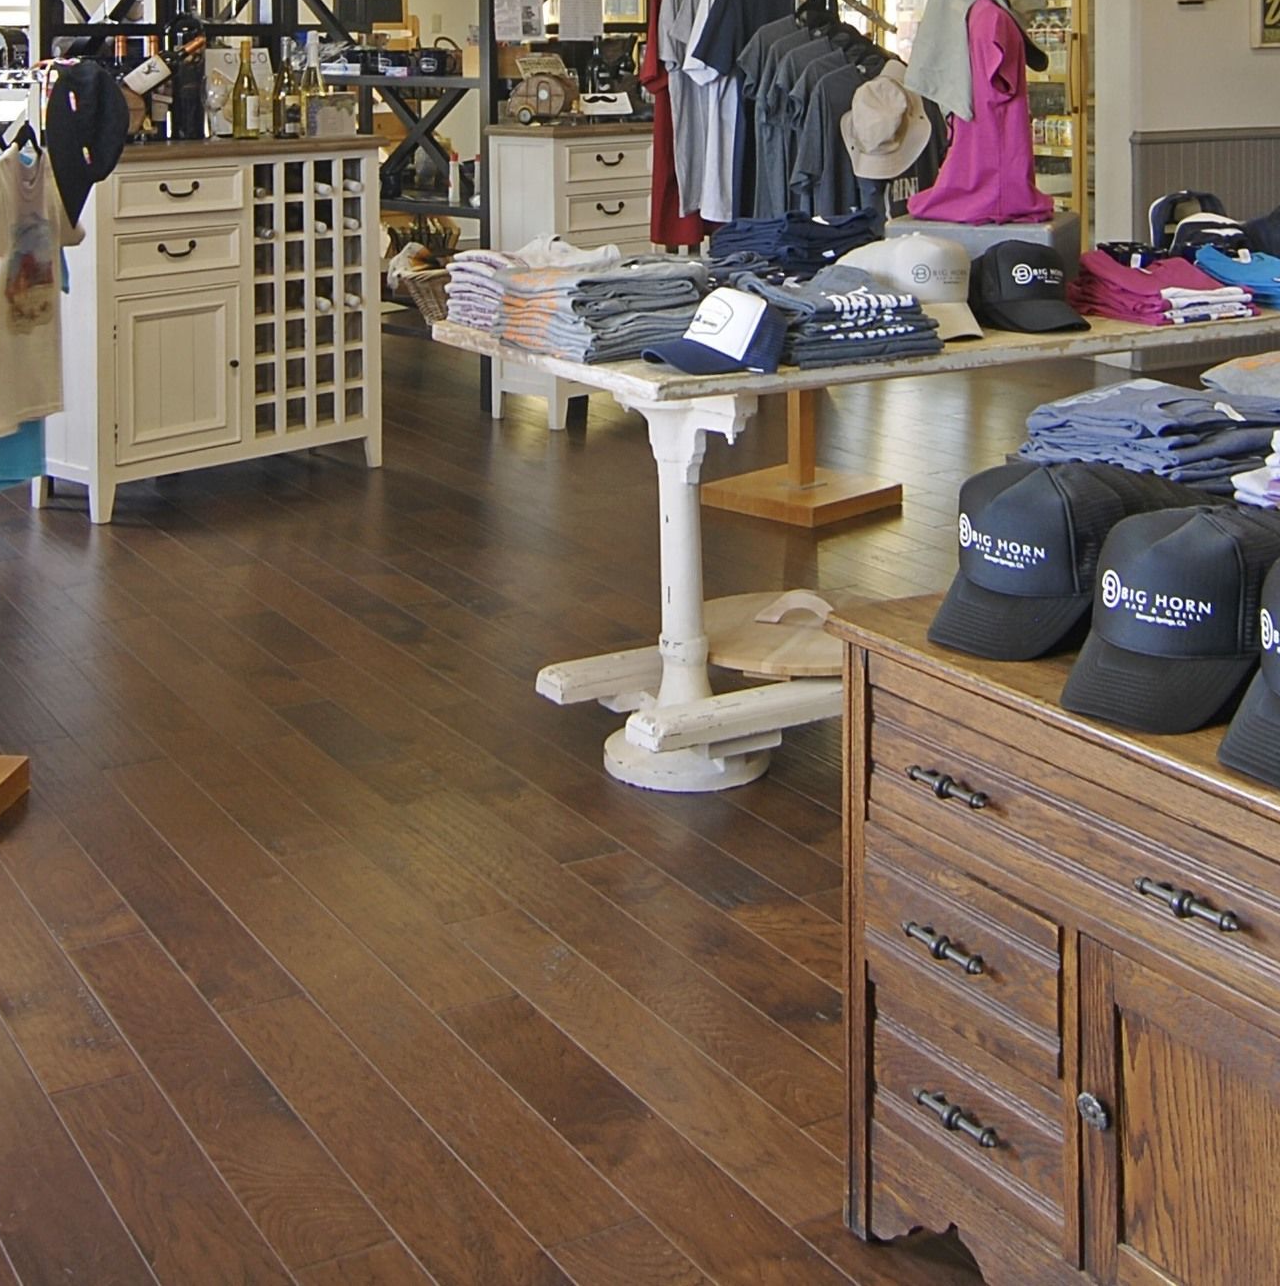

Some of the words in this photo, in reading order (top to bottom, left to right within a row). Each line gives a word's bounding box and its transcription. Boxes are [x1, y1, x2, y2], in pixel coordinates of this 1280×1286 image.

[972, 530, 992, 547] BIG
[998, 538, 1046, 559] HORN
[1006, 552, 1037, 565] GRILL
[1121, 586, 1147, 605] BIG
[1155, 593, 1212, 615] HORN
[1165, 610, 1201, 622] GRILL
